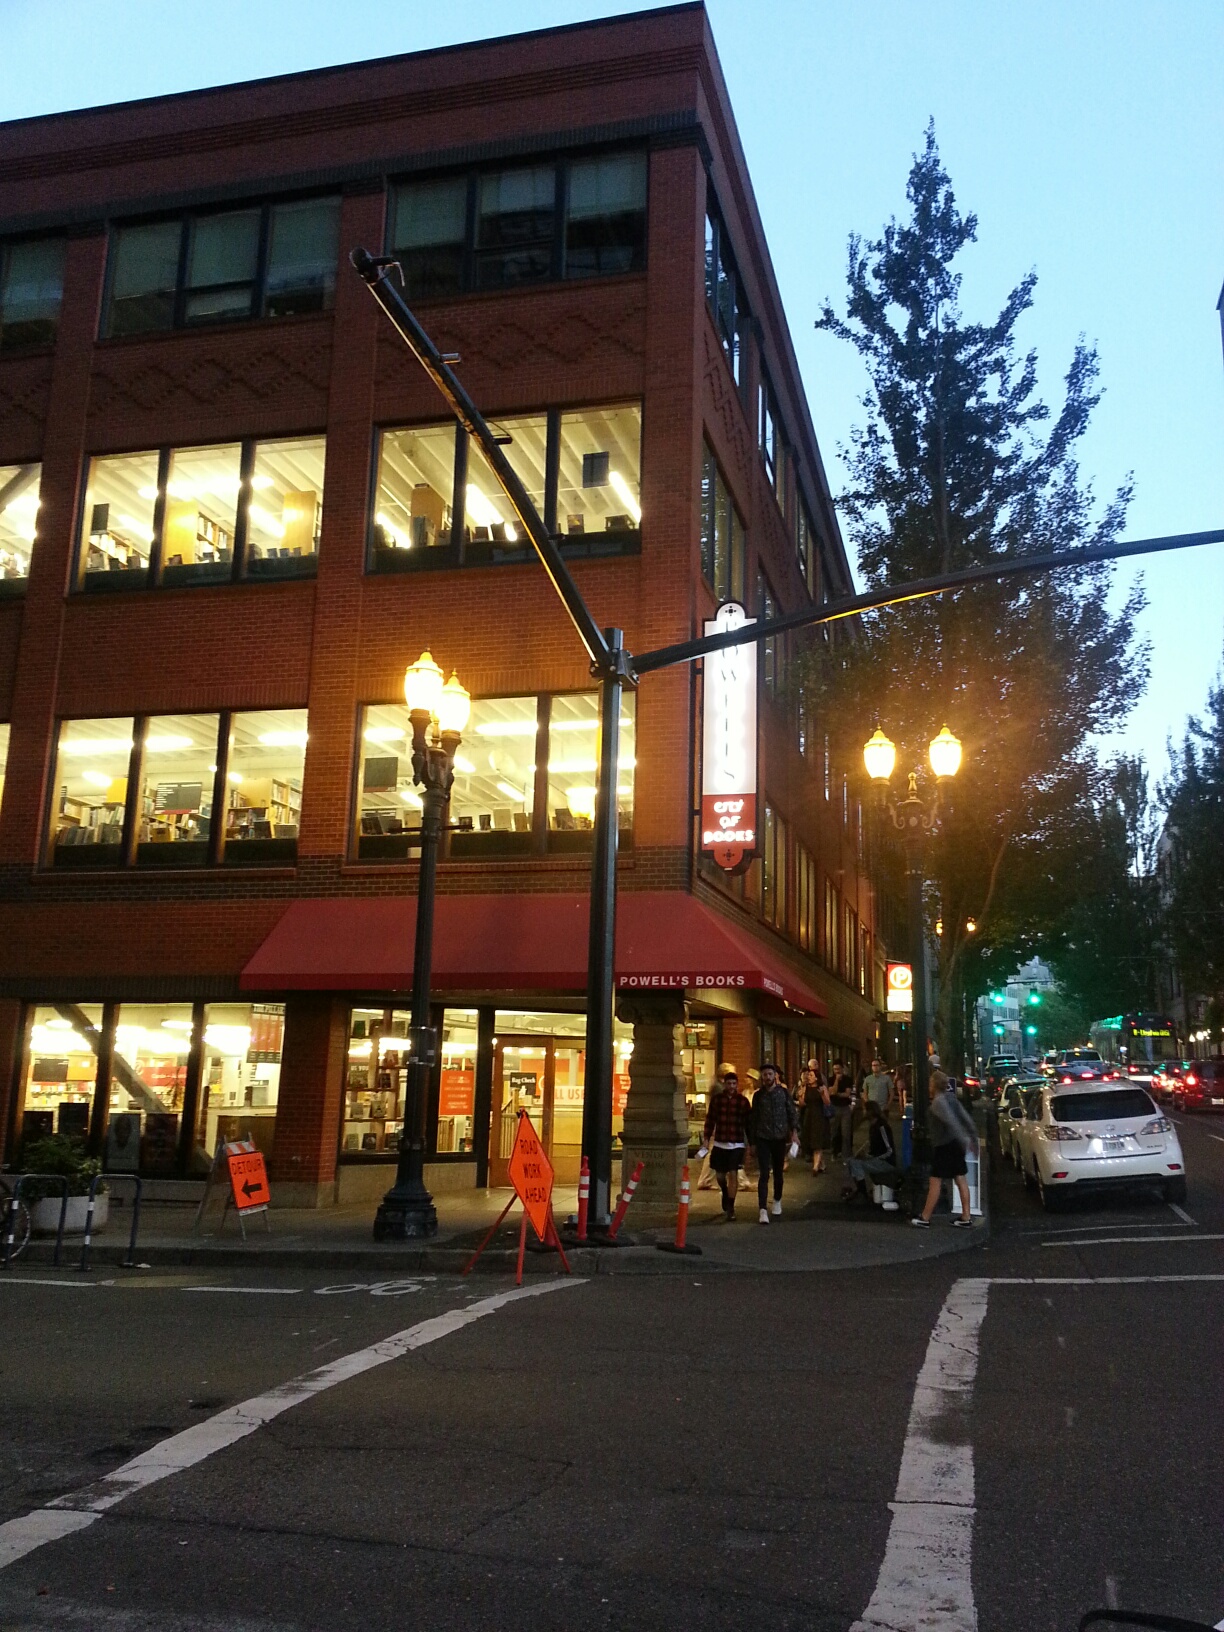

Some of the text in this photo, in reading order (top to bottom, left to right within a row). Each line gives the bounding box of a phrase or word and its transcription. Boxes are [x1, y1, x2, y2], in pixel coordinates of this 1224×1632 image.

[620, 975, 745, 986] POWELL'S BOOKS
[519, 1138, 539, 1155] ROAD
[231, 1159, 262, 1176] DETOUR
[523, 1163, 542, 1179] WORK
[525, 1187, 547, 1204] AHEAD
